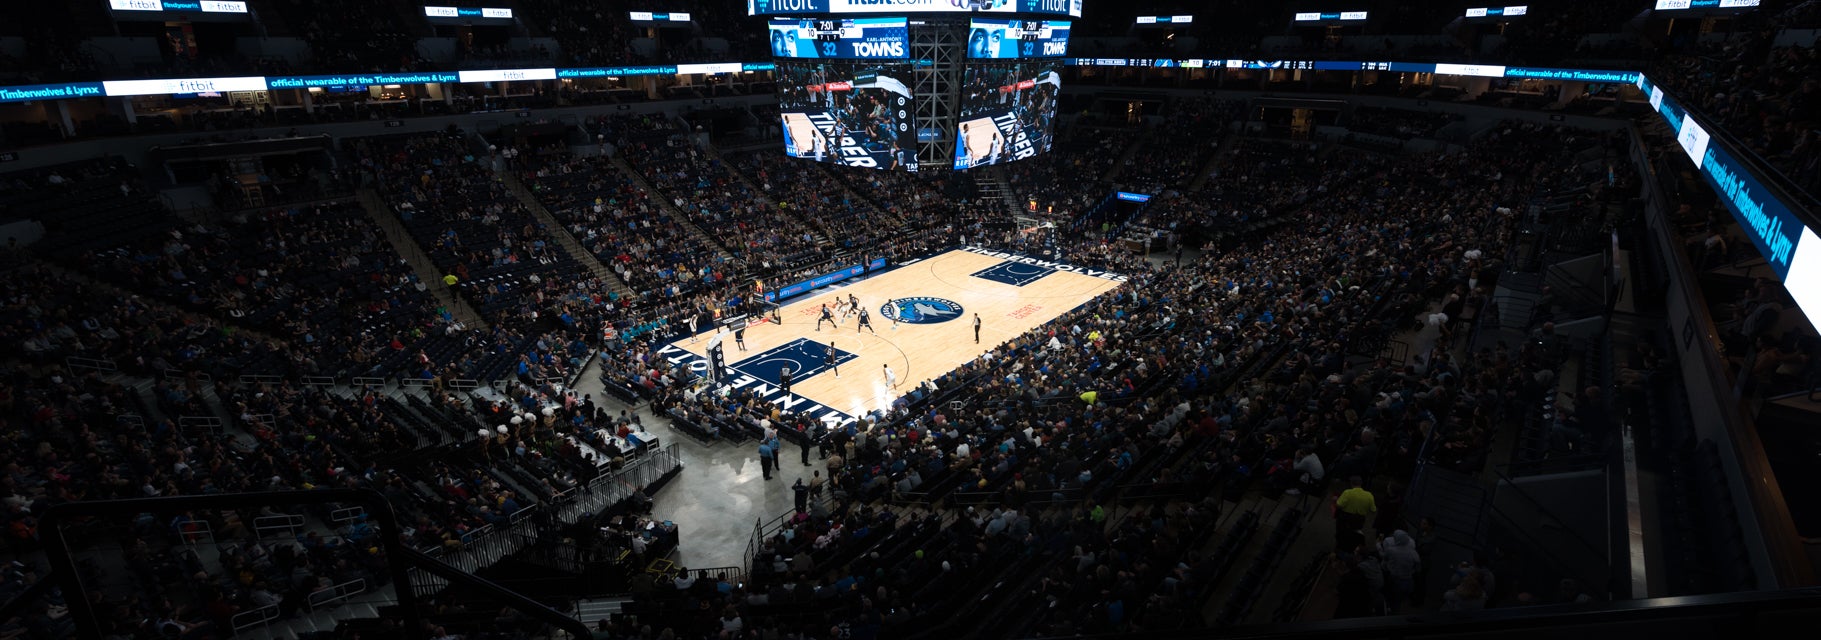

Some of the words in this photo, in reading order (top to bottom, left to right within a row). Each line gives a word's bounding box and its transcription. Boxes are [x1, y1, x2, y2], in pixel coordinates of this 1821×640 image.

[217, 3, 241, 11] fitbit
[820, 21, 834, 31] 7:01
[807, 29, 815, 37] 10
[840, 29, 845, 37] 9
[823, 41, 837, 56] 32
[852, 42, 904, 57] TOWNS
[1022, 42, 1034, 56] 32
[1043, 42, 1066, 55] TOWNS
[623, 67, 659, 75] Timberwolves
[1506, 69, 1526, 77] official
[1526, 70, 1553, 78] wearable
[1553, 70, 1561, 78] of
[1561, 71, 1573, 79] the
[1573, 71, 1621, 81] Timberwolves
[180, 80, 215, 91] fitbit
[271, 78, 304, 87] official
[305, 77, 347, 86] wearable
[348, 76, 357, 85] of
[357, 76, 374, 84] the
[374, 75, 430, 84] Timberwolves
[431, 74, 438, 82] &
[438, 74, 457, 83] Lynx
[0, 87, 64, 99] Timberwolves
[66, 86, 73, 96] &
[73, 85, 99, 97] Lynx
[1733, 180, 1770, 239] Timberwolves
[1765, 215, 1777, 247] &
[1770, 220, 1792, 267] Lynx
[963, 246, 1128, 283] TIMBERWOLVES
